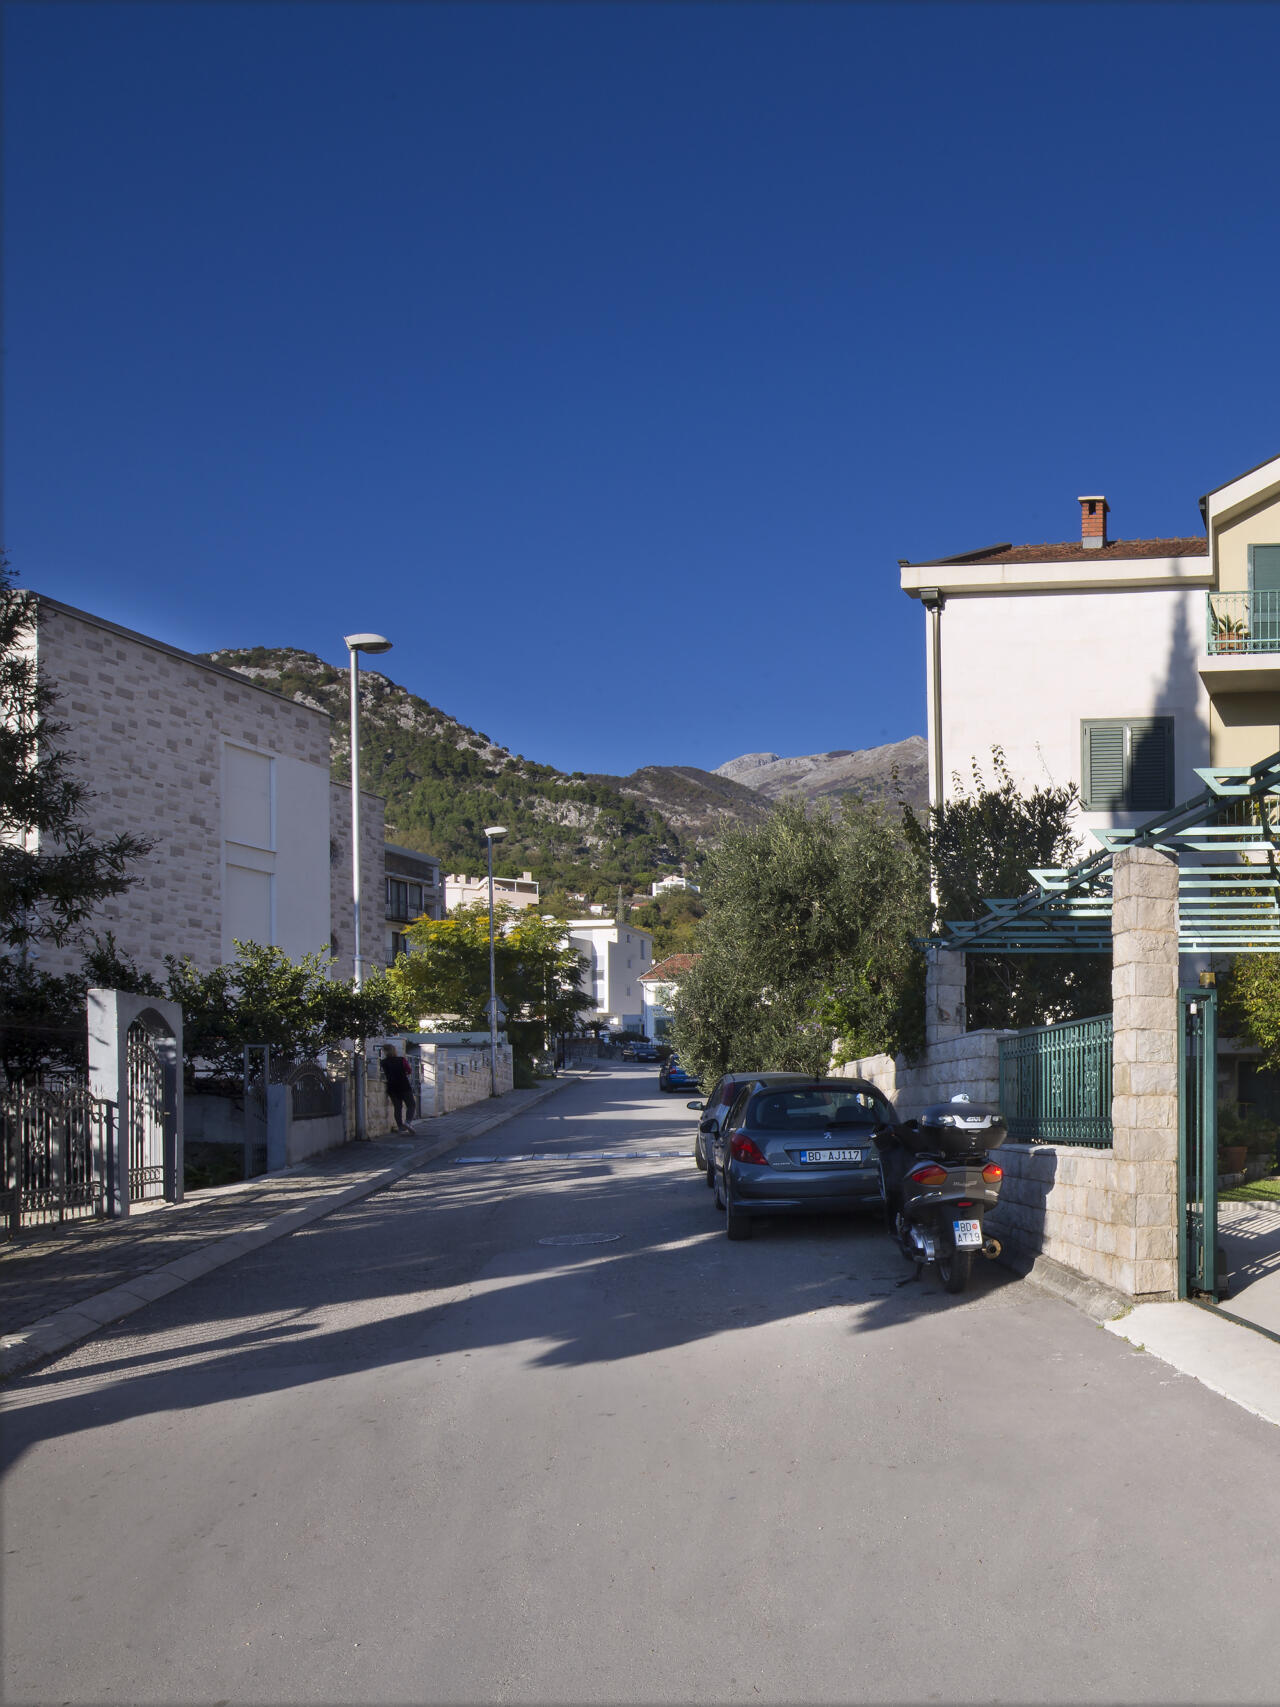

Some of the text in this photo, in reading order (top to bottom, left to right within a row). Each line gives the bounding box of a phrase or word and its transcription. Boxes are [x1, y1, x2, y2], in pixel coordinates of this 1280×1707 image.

[808, 1151, 859, 1161] BD AJ117
[960, 1222, 972, 1232] BD
[958, 1232, 980, 1242] AT19
